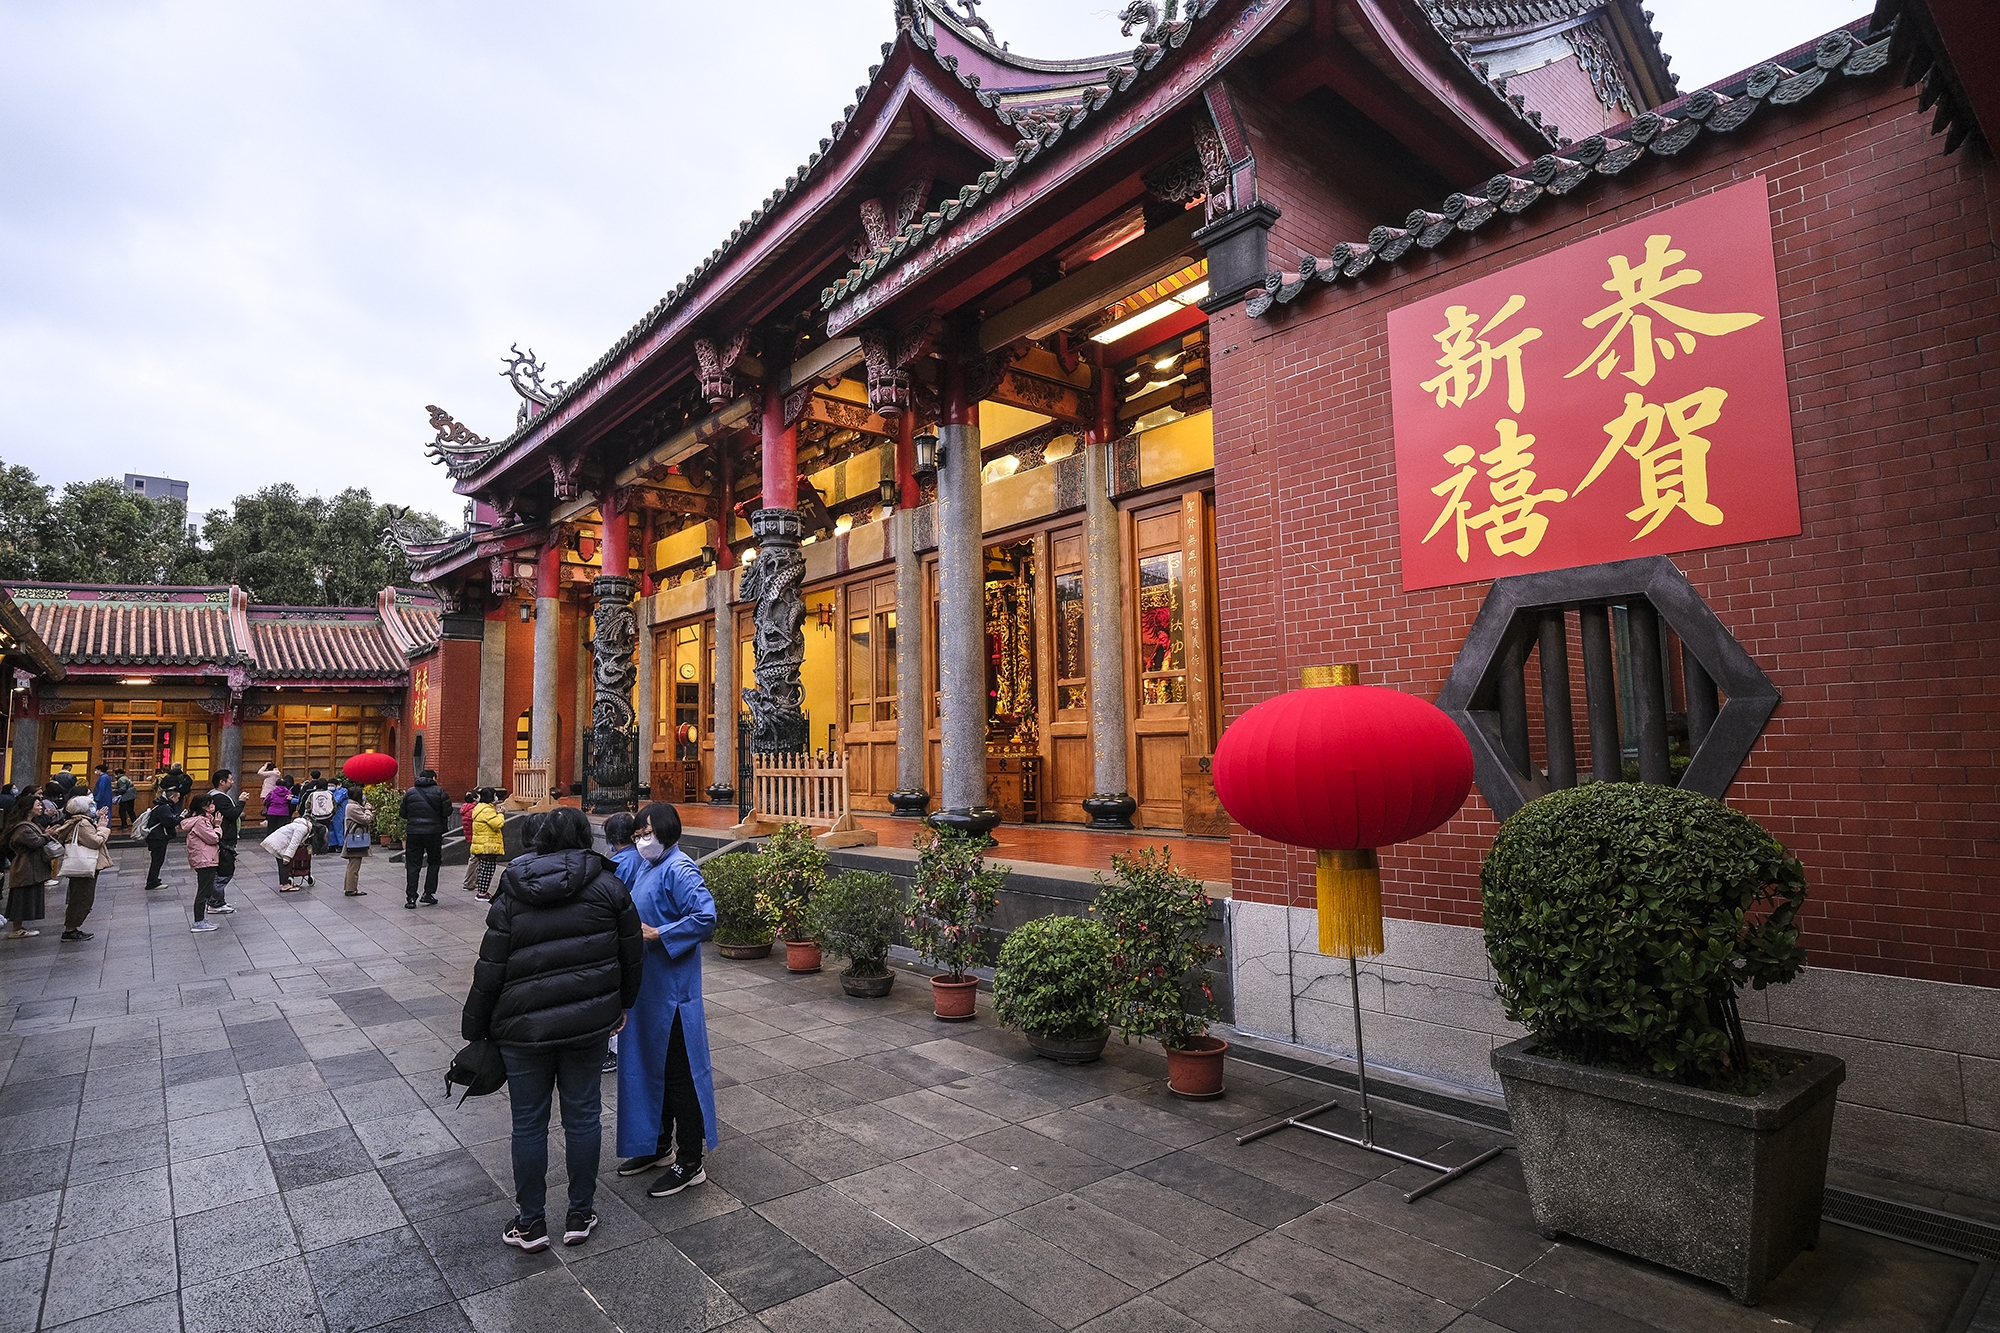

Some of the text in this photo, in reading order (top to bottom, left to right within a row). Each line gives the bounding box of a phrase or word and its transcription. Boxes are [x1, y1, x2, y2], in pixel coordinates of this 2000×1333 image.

[1420, 295, 1568, 563] 新禧
[1564, 234, 1765, 541] 恭賀
[421, 666, 429, 725] 恭賀
